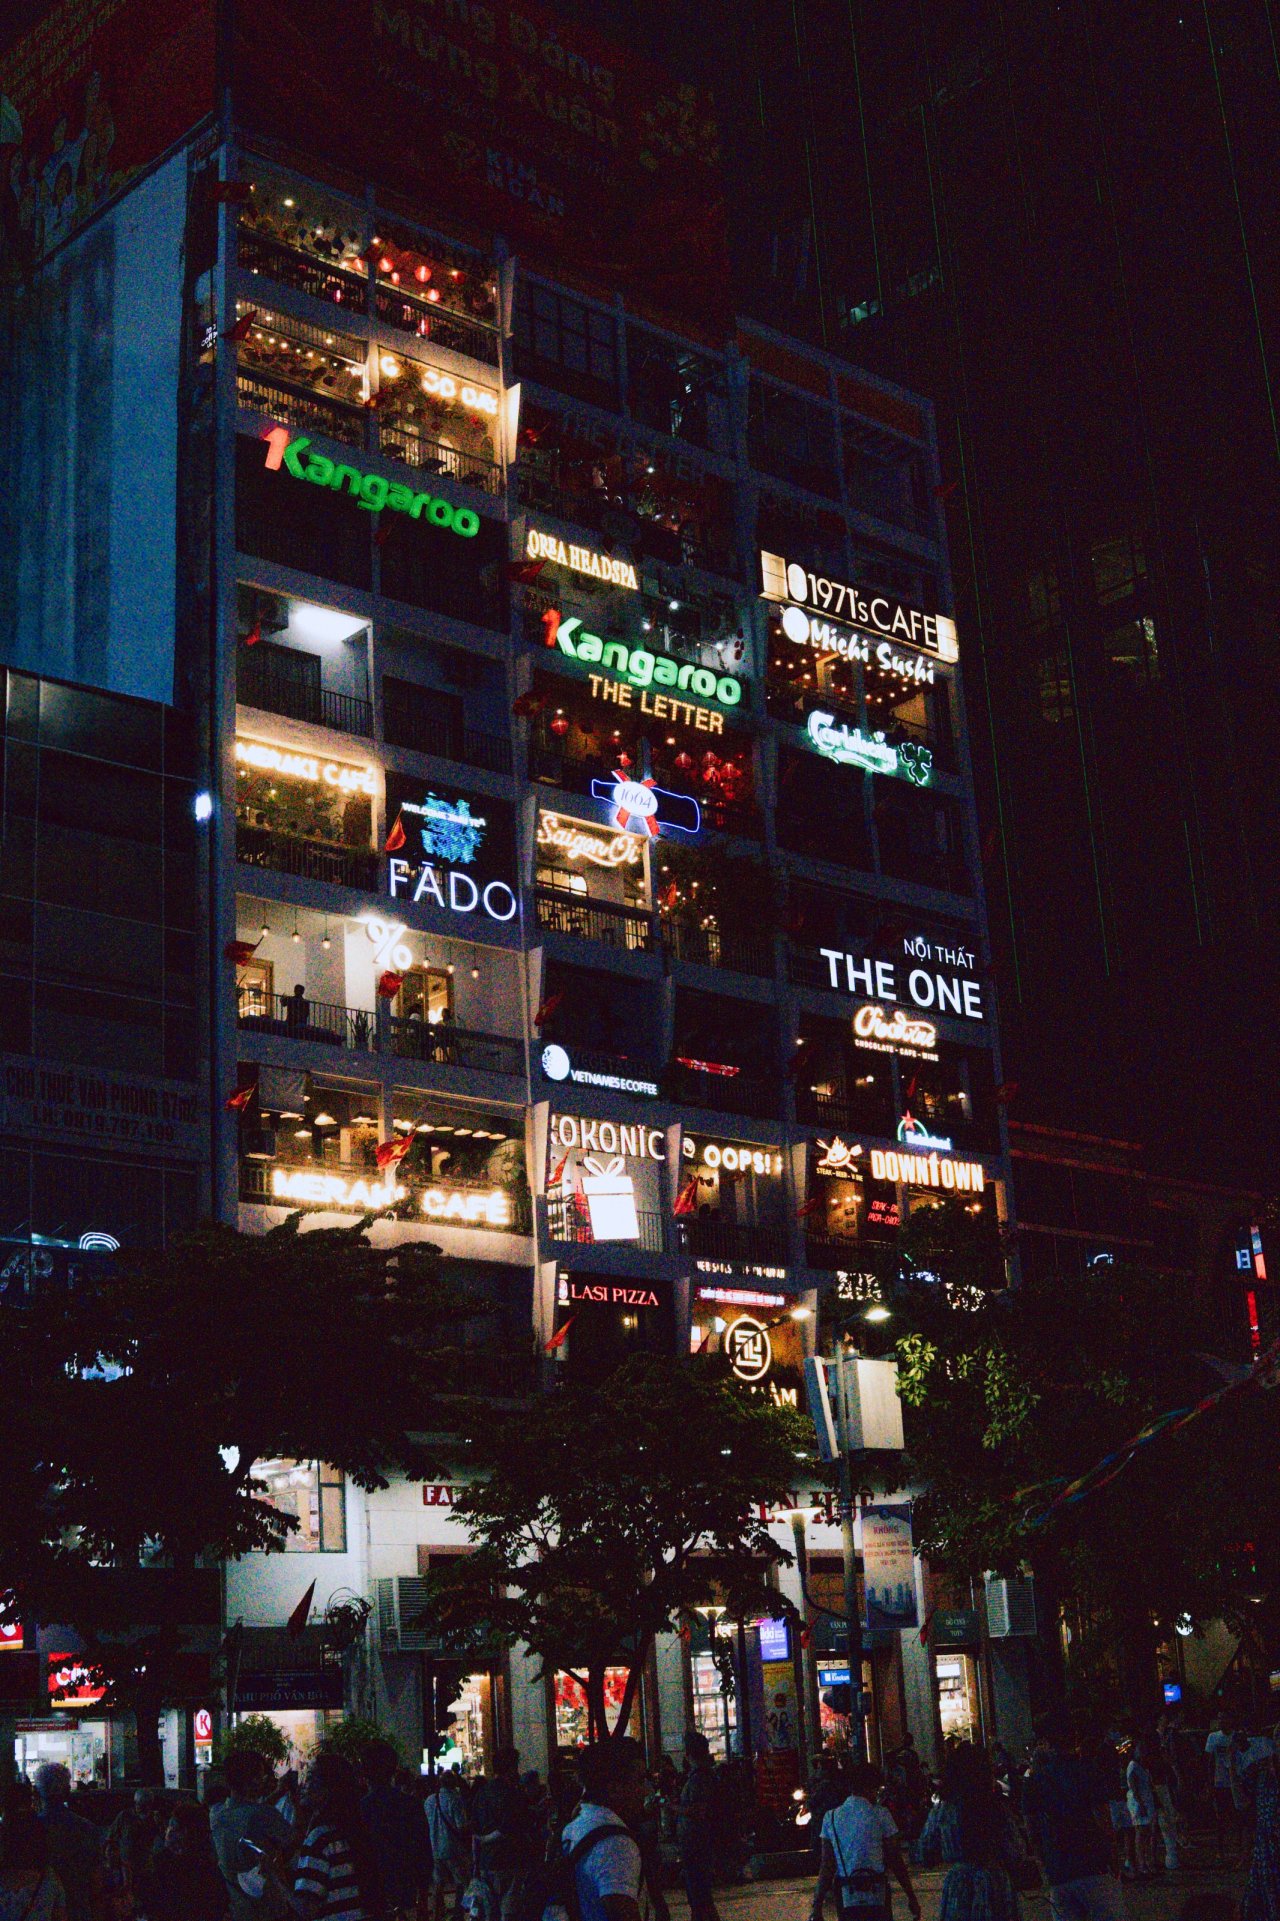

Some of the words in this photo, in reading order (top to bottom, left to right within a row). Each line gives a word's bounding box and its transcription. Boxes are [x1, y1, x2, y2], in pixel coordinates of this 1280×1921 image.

[283, 437, 480, 538] Kangaroo
[870, 598, 938, 648] CAFE
[556, 617, 742, 705] Kangaroo
[876, 643, 934, 684] Sushi
[588, 673, 633, 708] THE
[640, 691, 724, 735] LETTER
[934, 945, 975, 969] THẤT
[820, 948, 897, 1001] THE
[908, 969, 983, 1019] ONE
[855, 1039, 894, 1053] CHOCOLATE
[571, 1283, 608, 1302] LASI
[612, 1288, 659, 1306] PIZZA
